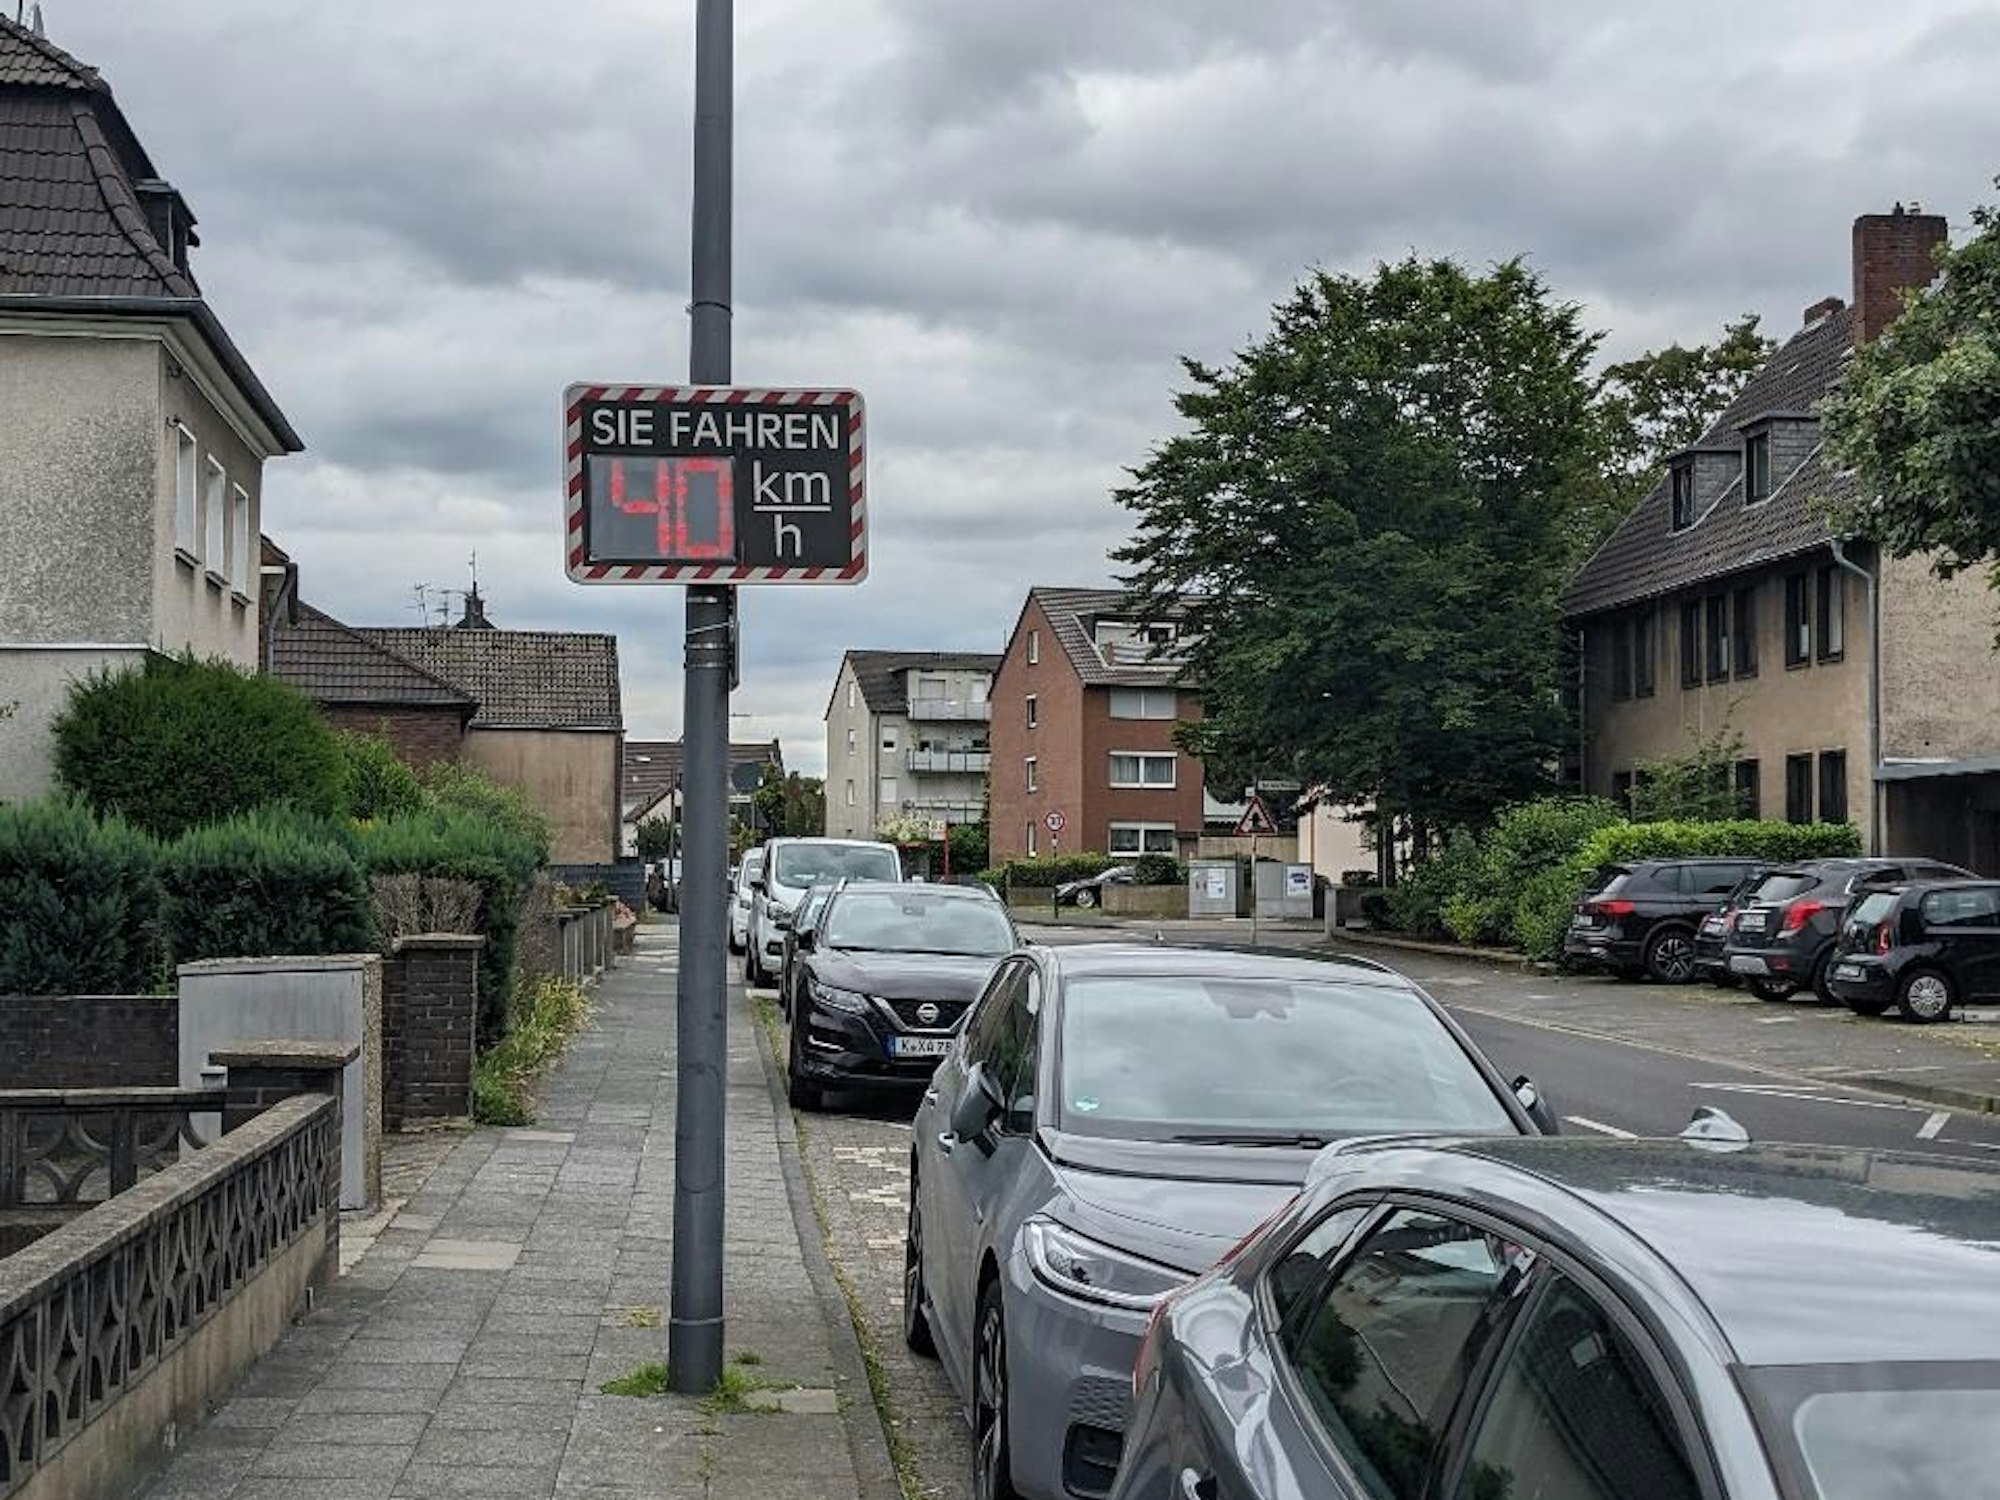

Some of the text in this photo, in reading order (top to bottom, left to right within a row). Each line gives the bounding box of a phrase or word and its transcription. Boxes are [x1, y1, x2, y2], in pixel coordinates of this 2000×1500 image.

[592, 408, 839, 449] SIE FAHREN
[752, 459, 831, 504] km
[610, 456, 734, 557] 40
[773, 513, 801, 558] h
